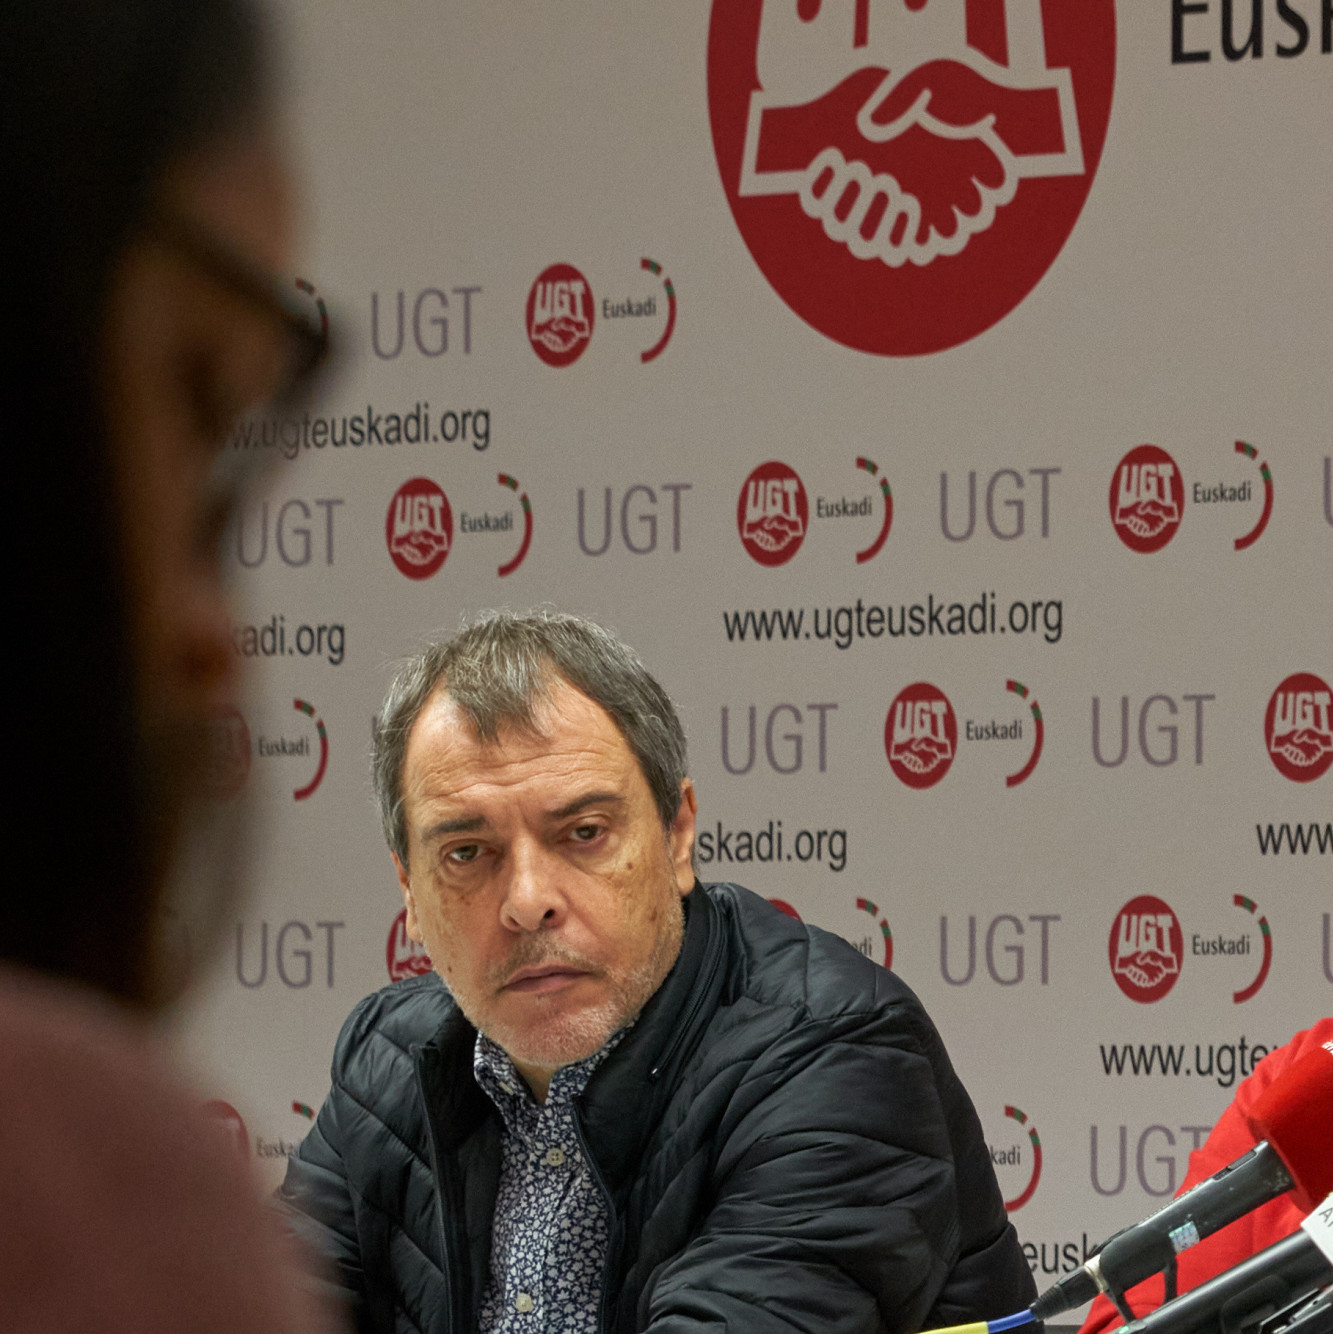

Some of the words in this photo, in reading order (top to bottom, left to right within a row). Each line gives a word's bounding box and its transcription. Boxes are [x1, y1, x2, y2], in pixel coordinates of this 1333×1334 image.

[371, 285, 482, 360] UGT
[532, 280, 588, 322] UGT
[602, 296, 656, 319] Euskadi
[747, 478, 801, 519] UGT
[815, 496, 873, 519] Euskadi
[939, 467, 1062, 543] UGT
[1120, 463, 1175, 505] UGT
[1191, 480, 1252, 505] Euskadi
[398, 493, 445, 532] UGT
[460, 510, 514, 534] Euskadi
[575, 482, 692, 558] UGT
[724, 591, 1063, 649] www.ugteuskadi.org
[719, 702, 839, 776] UGT
[893, 700, 950, 742] UGT
[965, 719, 1023, 742] Euskadi
[1091, 694, 1216, 768] UGT
[1275, 691, 1332, 735] UGT
[235, 920, 345, 988] UGT
[938, 912, 1061, 986] UGT
[1119, 913, 1176, 957] UGT
[1192, 934, 1251, 957] Euskadi
